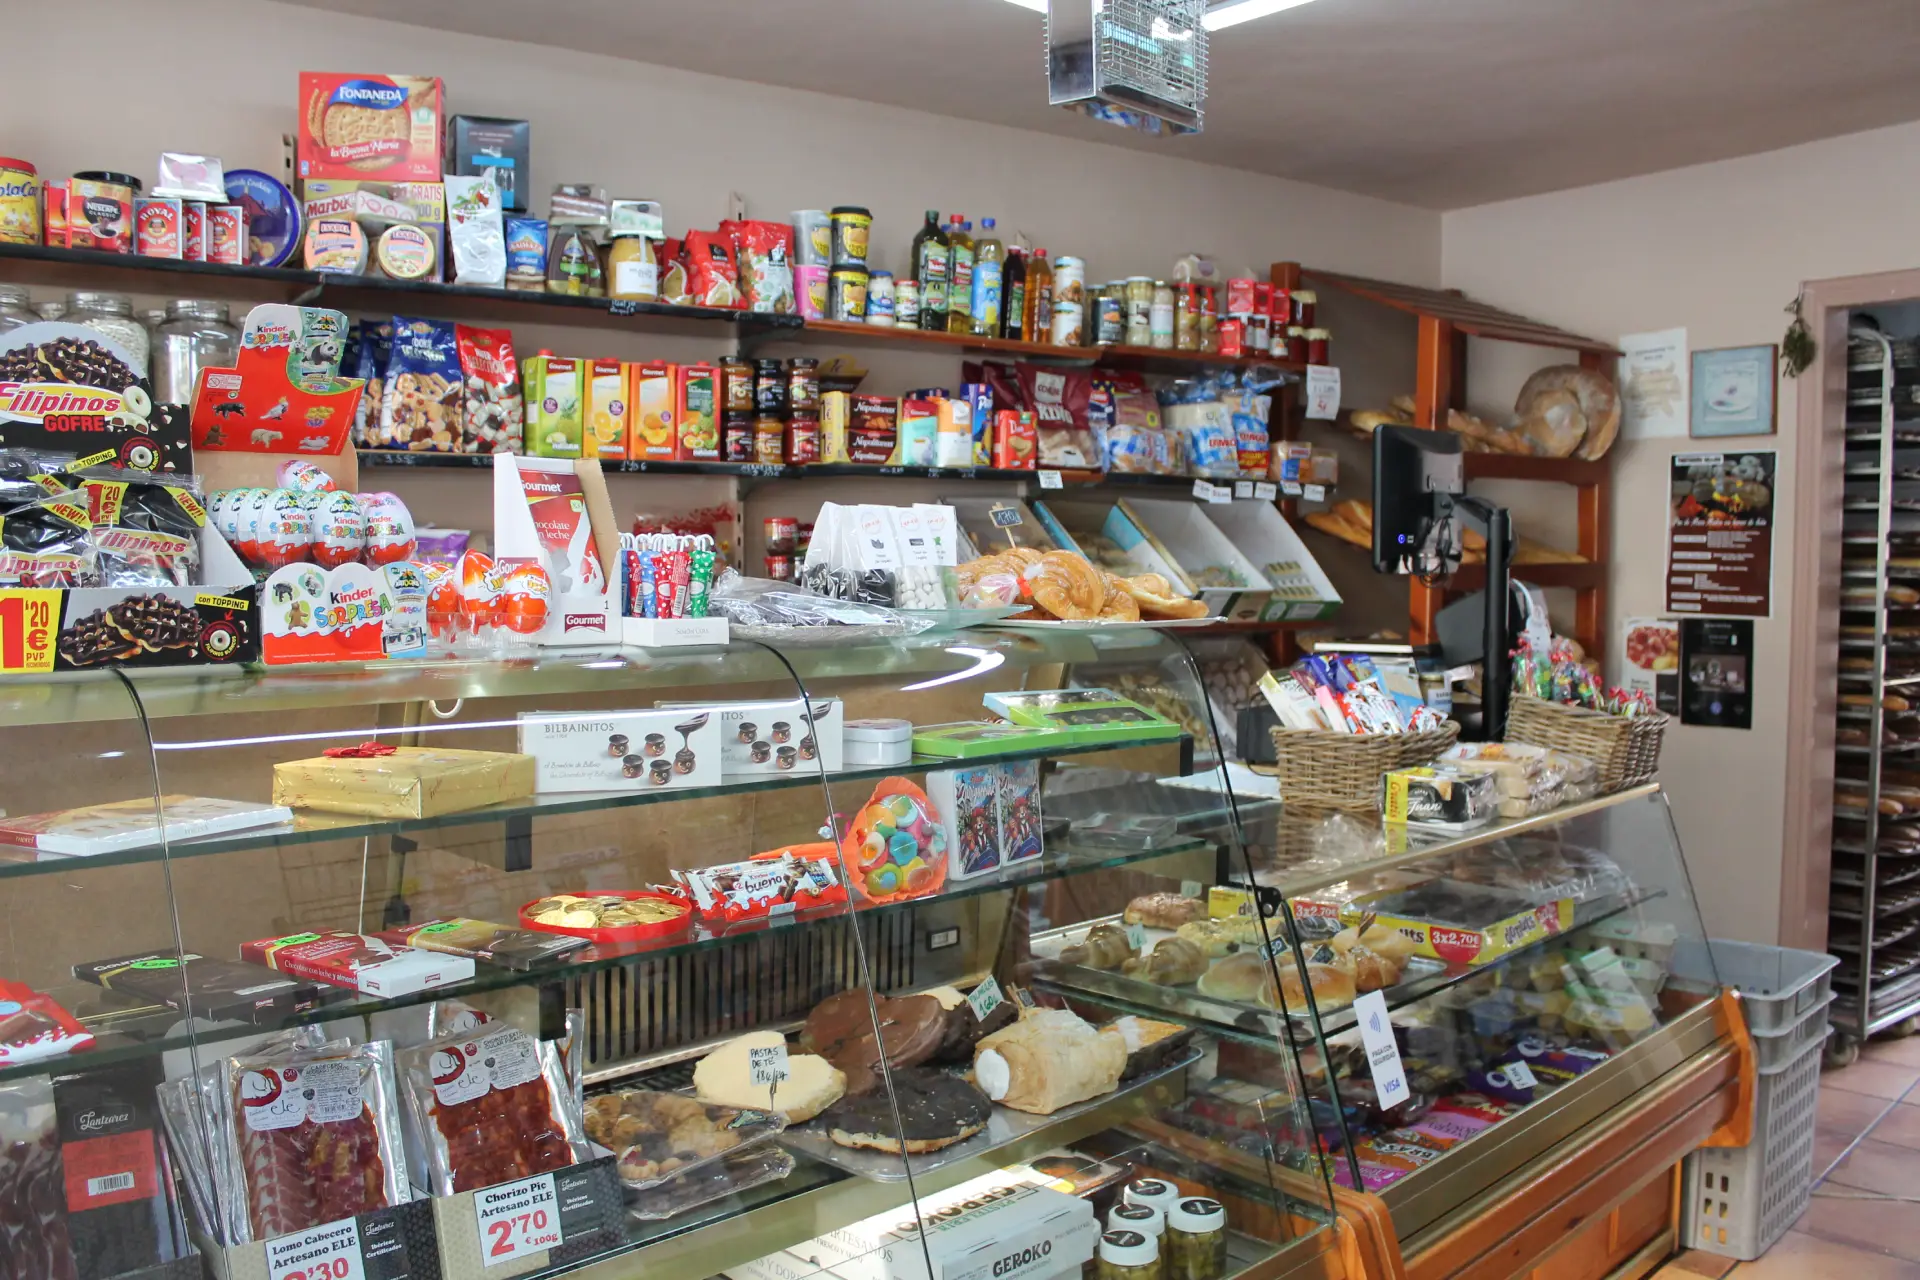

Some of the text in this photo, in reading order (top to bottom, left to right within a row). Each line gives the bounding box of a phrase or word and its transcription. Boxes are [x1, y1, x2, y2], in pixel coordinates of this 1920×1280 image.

[340, 86, 402, 101] FONTANEDA
[44, 414, 105, 432] GOFRE
[81, 451, 113, 468] TOPPING
[176, 491, 204, 519] NEW!!
[545, 530, 570, 540] leche
[211, 598, 245, 609] TOPPING
[313, 593, 392, 628] SORPRESA
[566, 616, 604, 627] Gourmet
[26, 652, 45, 662] PVP
[545, 722, 615, 733] BILBAINITOS
[1408, 800, 1442, 815] Juan
[744, 874, 782, 893] bueno
[308, 966, 318, 974] con
[750, 1047, 779, 1058] PASTAS
[752, 1059, 762, 1069] DE
[1384, 1078, 1401, 1094] VISA
[270, 1099, 301, 1115] ele
[485, 1182, 547, 1204] Chorizo Pic
[480, 1191, 554, 1218] Artesano ELE
[272, 1226, 352, 1255] Lomo Cabecero
[488, 1209, 548, 1257] 2'70
[525, 1233, 558, 1246] € 100g
[273, 1236, 356, 1269] Artesano ELE
[366, 1243, 402, 1258] Certificados
[992, 1239, 1052, 1277] GEROKO
